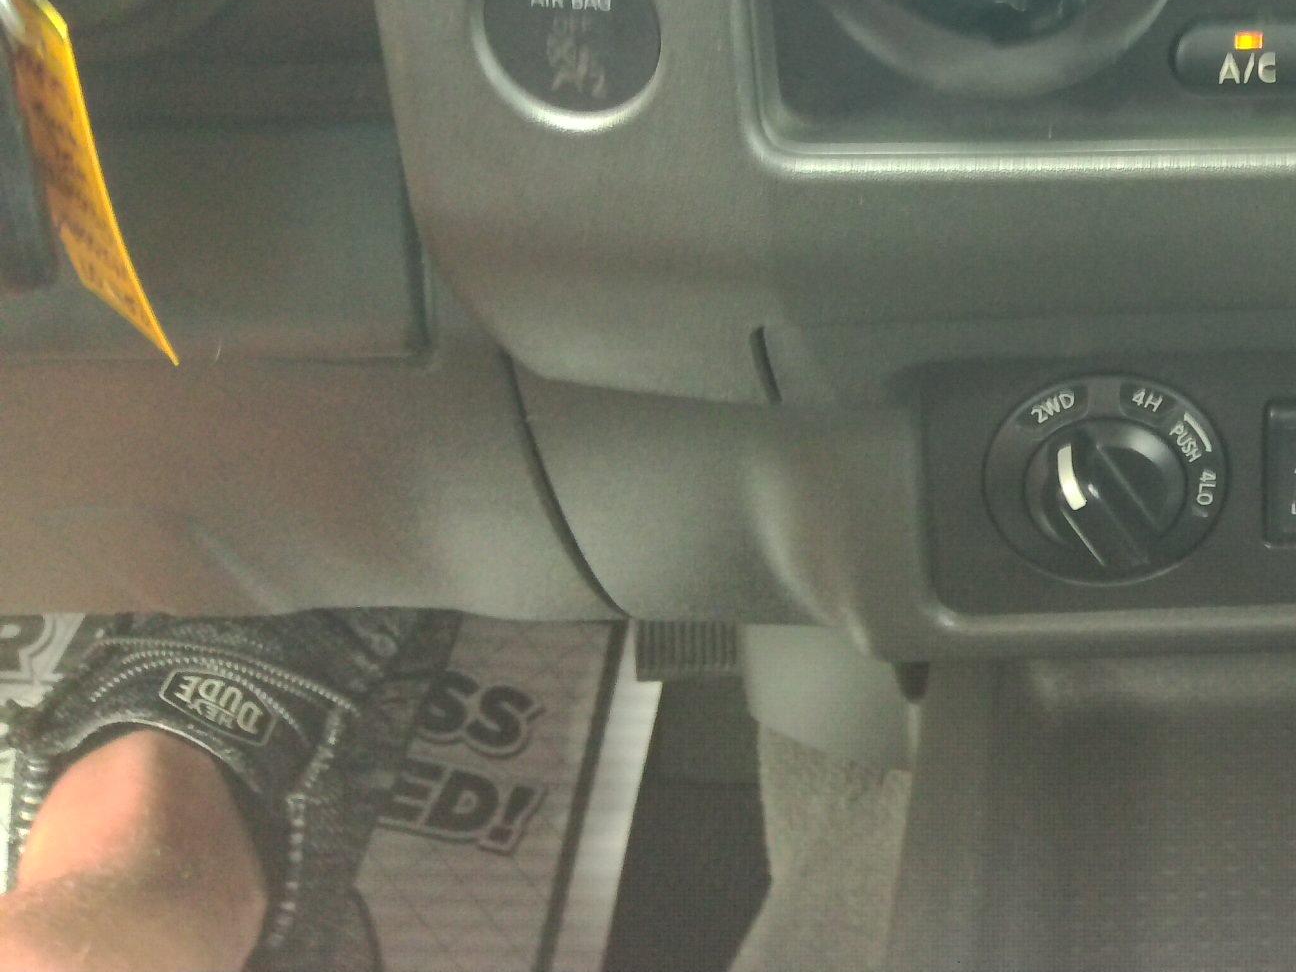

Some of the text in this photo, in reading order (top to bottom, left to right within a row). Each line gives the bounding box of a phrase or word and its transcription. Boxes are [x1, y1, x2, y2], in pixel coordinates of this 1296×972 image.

[1219, 51, 1277, 85] A/C
[1030, 390, 1076, 425] 2WD
[1131, 387, 1164, 414] 4H
[1168, 420, 1202, 464] PUSH
[1195, 468, 1217, 507] 4LO
[174, 674, 263, 734] DUDE
